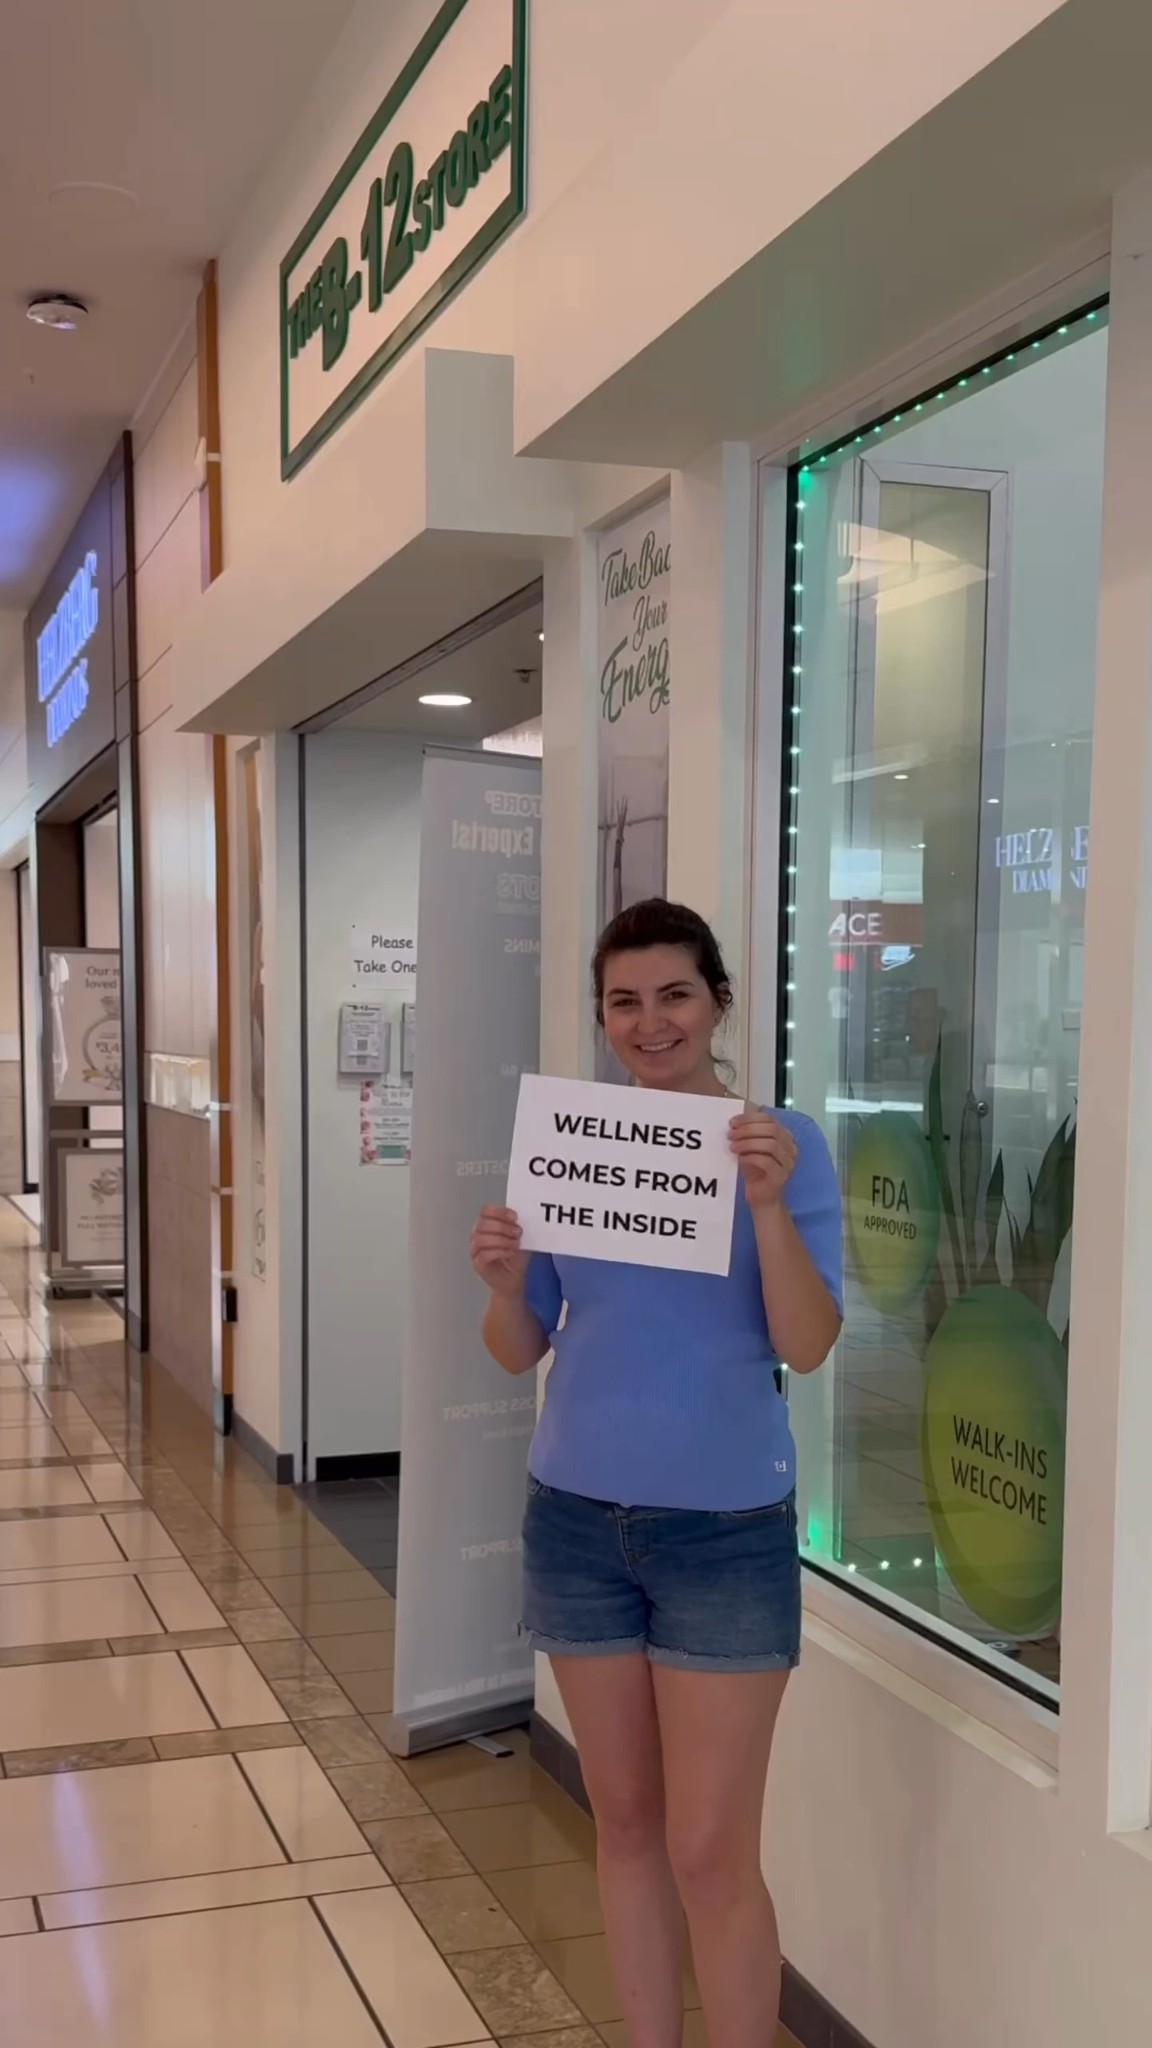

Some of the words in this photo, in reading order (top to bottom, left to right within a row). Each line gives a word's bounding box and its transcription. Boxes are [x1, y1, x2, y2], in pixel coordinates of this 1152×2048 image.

[287, 265, 325, 359] THE
[321, 141, 415, 372] B-12
[411, 64, 513, 252] STORE
[602, 548, 638, 606] Take
[633, 595, 668, 652] Your
[600, 635, 671, 724] Energ
[371, 935, 414, 949] Please
[828, 912, 883, 936] ACE
[85, 978, 117, 989] loved
[86, 965, 110, 976] Our
[354, 959, 387, 973] Take
[391, 960, 417, 974] One
[554, 1112, 702, 1150] WELLNESS
[528, 1156, 626, 1187] COMES
[634, 1169, 719, 1198] FROM
[871, 1174, 911, 1214] FDA
[539, 1202, 595, 1228] THE
[602, 1210, 698, 1240] INSIDE
[863, 1215, 918, 1240] APPROVED
[951, 1412, 1048, 1481] WALK-INS
[949, 1454, 1048, 1527] WELCOME
